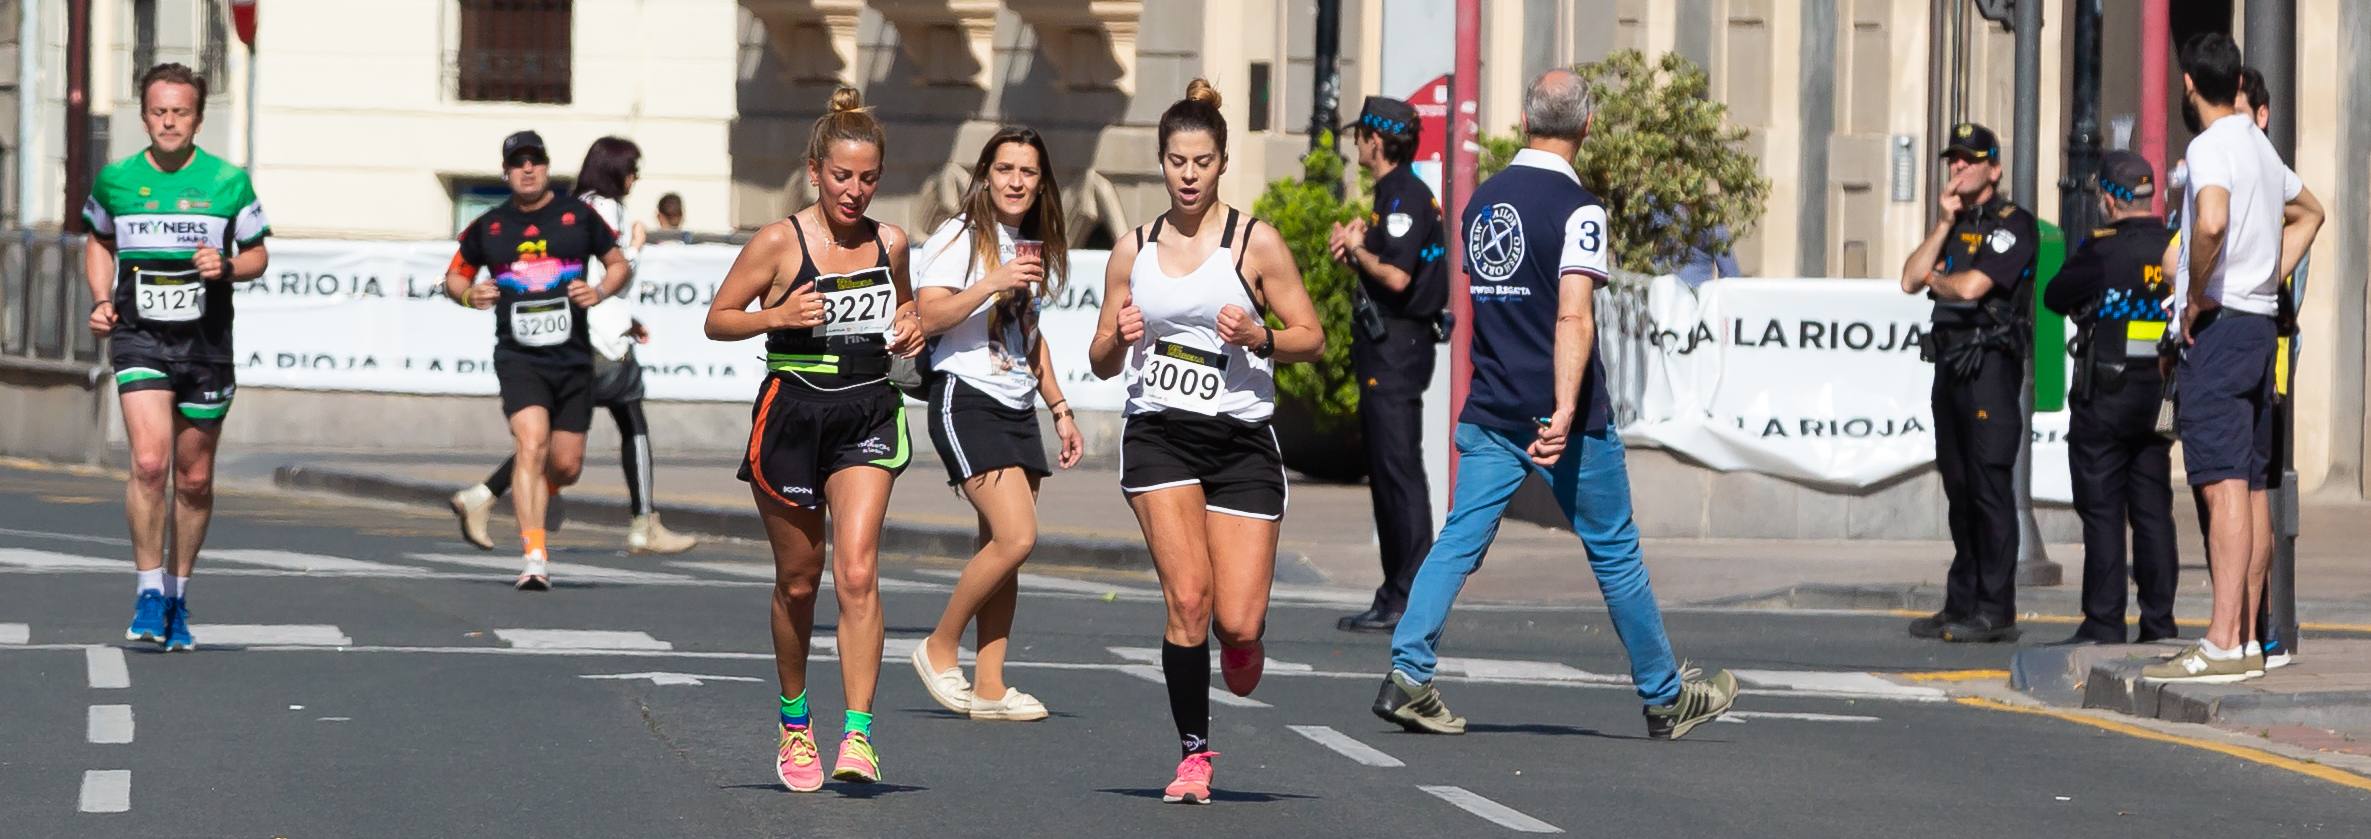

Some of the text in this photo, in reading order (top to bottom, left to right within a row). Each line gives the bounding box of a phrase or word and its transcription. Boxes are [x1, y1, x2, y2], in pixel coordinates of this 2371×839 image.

[128, 221, 208, 235] TRYNERS
[1579, 220, 1600, 252] 3
[141, 287, 203, 310] 3127
[640, 281, 716, 305] RIOJ
[824, 290, 891, 325] 3227
[518, 314, 568, 336] 3200
[1734, 318, 1789, 347] LA
[1799, 320, 1922, 350] RIOJA
[1145, 361, 1219, 401] 3009
